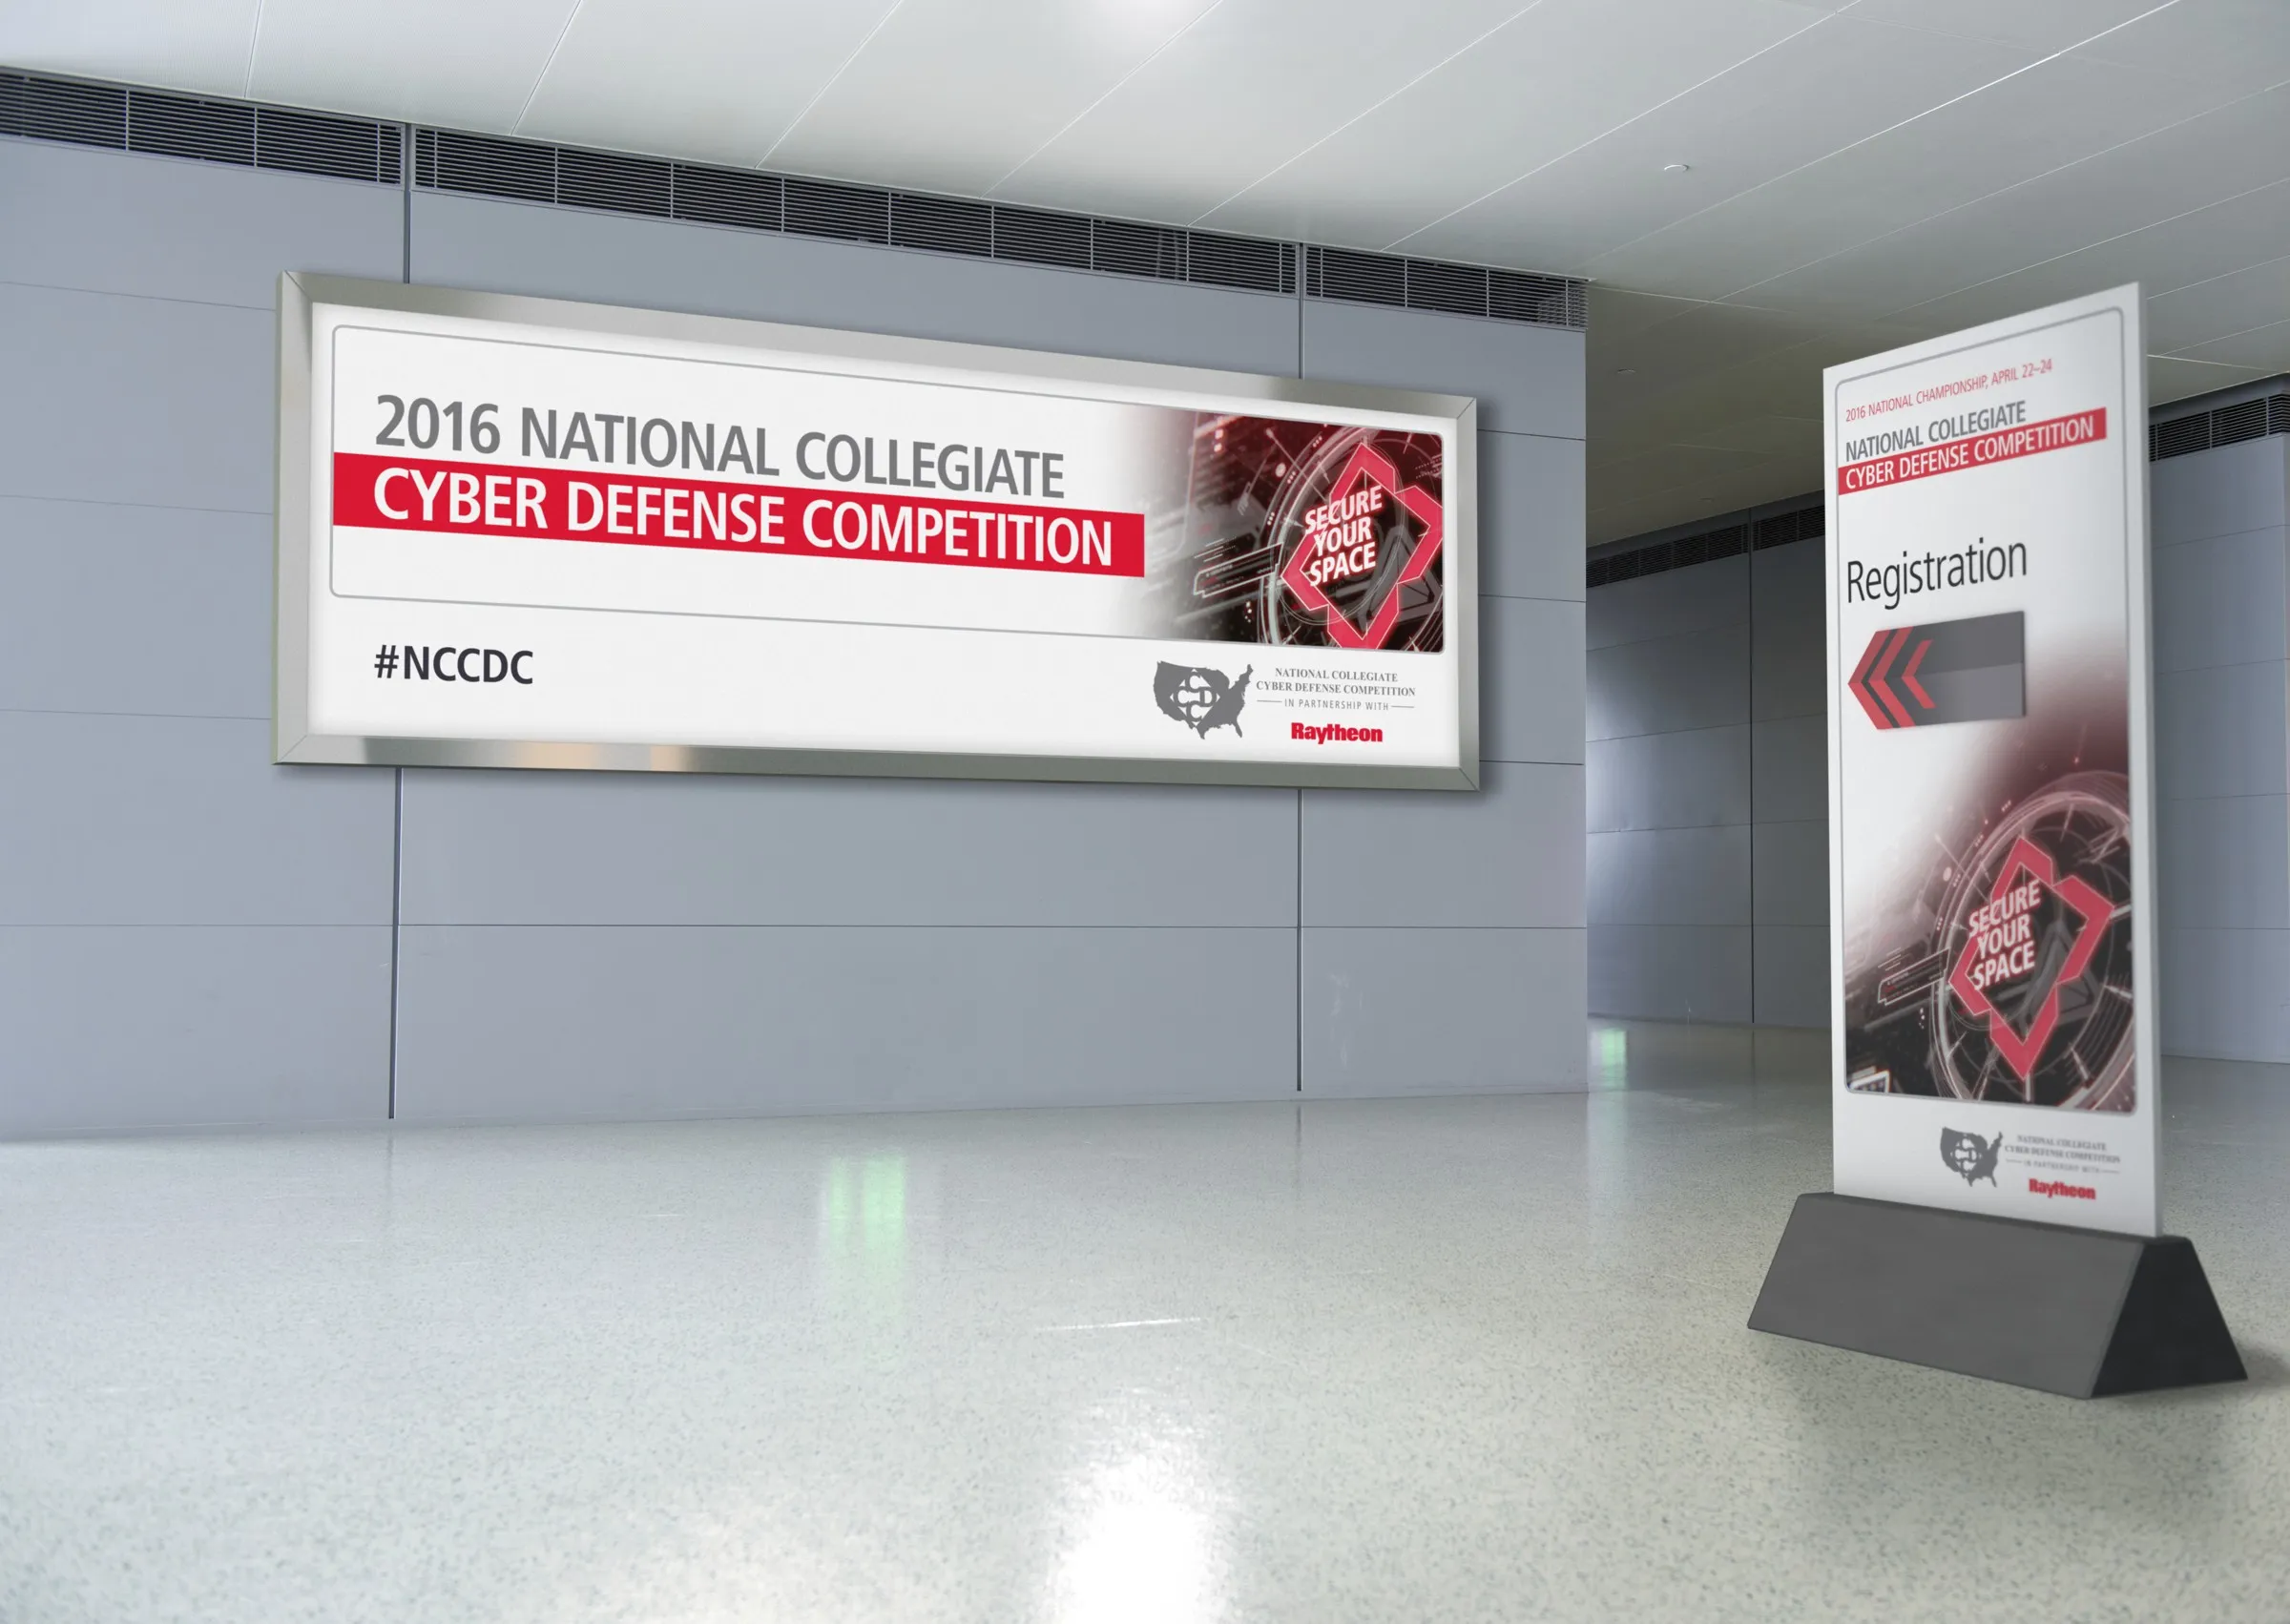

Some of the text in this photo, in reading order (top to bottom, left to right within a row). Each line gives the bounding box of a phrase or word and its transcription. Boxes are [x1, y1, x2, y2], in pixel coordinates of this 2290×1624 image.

[1845, 406, 1866, 422] 2016
[1868, 394, 1914, 416] NATIONAL
[1916, 375, 1988, 405] CHAMPIONSHIP,
[1991, 366, 2019, 386] APRIL
[374, 394, 1065, 498] 2016 NATIONAL COLLEGIATE
[1845, 400, 2027, 462] NATIONAL COLLEGIATE
[1845, 415, 2094, 489] CYBER DEFENSE COMPETITION
[373, 468, 1113, 567] CYBER DEFENSE COMPETITION
[1305, 485, 1383, 535] SECURE
[1313, 516, 1372, 557] YOUR
[1310, 542, 1376, 586] SPACE
[1847, 537, 2028, 610] Registration
[373, 644, 534, 685] #NCCDC
[1275, 668, 1399, 682] NATIONAL COLLEGIATE
[1256, 680, 1416, 697] CYBER DEFENSE COMPETITION
[1284, 698, 1388, 710] IN PARTNERSHIP WITH
[1291, 722, 1384, 744] Raytheon
[1969, 879, 2041, 938] SECURE
[1977, 913, 2030, 960] YOUR
[1974, 941, 2034, 990] SPACE
[2017, 1135, 2055, 1146] NATIONAL
[2029, 1177, 2096, 1199] Raytheon
